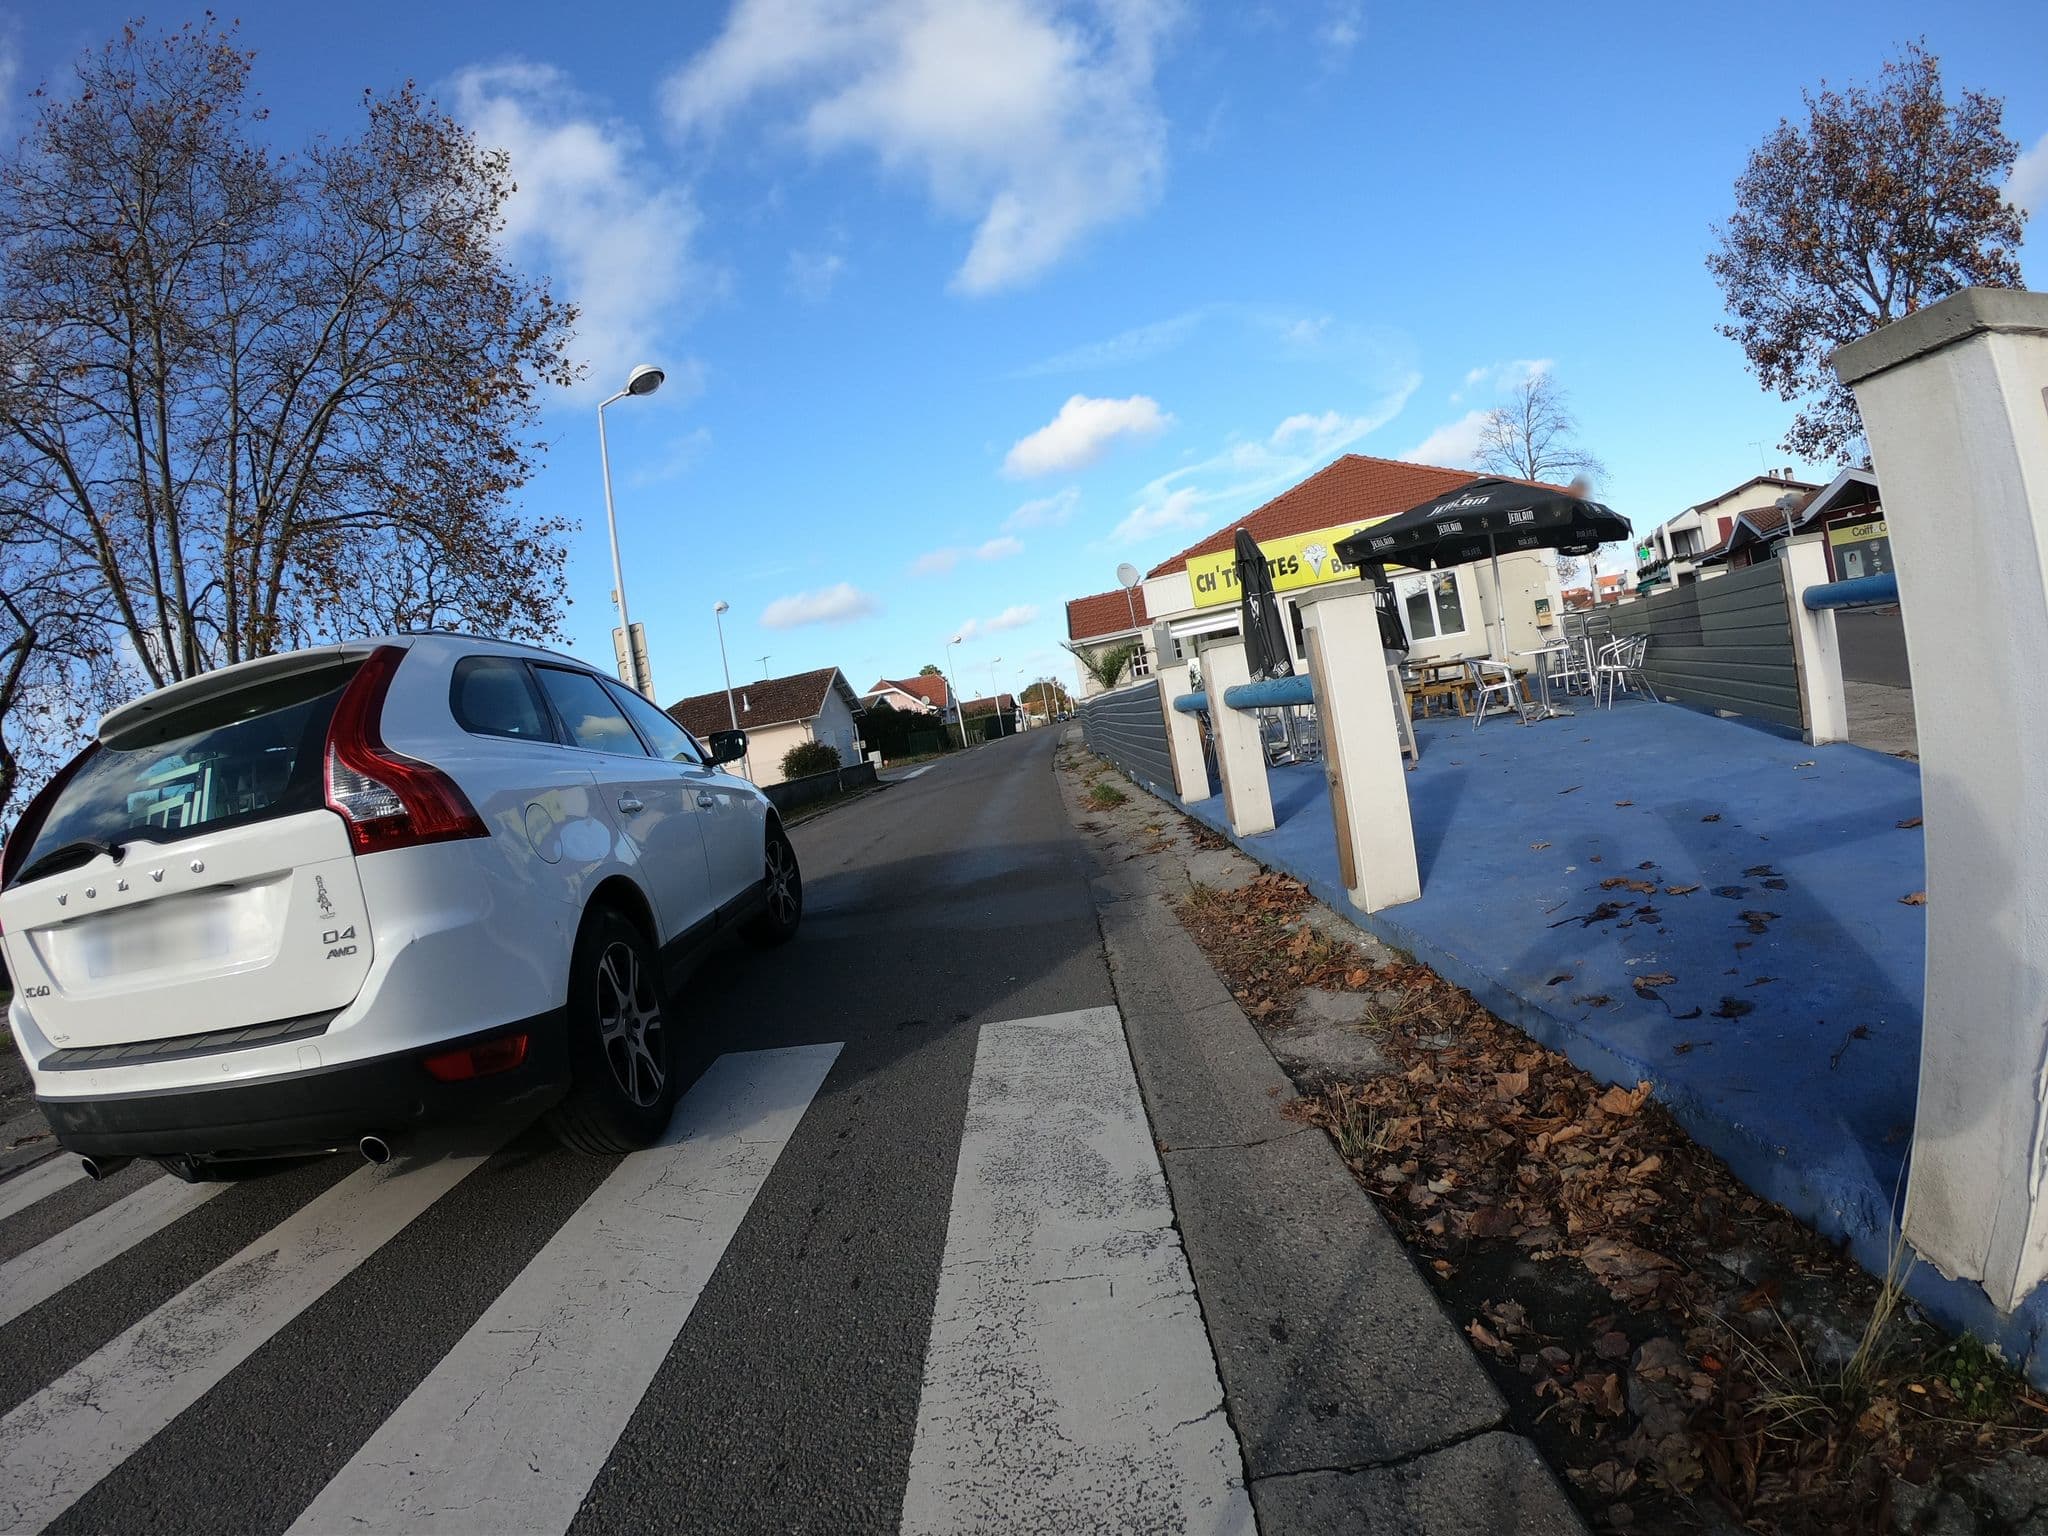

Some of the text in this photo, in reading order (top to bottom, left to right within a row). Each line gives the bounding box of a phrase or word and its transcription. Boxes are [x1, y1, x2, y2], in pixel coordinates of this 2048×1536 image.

[1507, 510, 1535, 525] JENLAIN
[1437, 522, 1463, 536] JENLAIN
[1370, 535, 1396, 550] JENLAIN
[56, 859, 205, 905] VOLVO
[323, 925, 356, 944] D4
[326, 945, 357, 959] AWD
